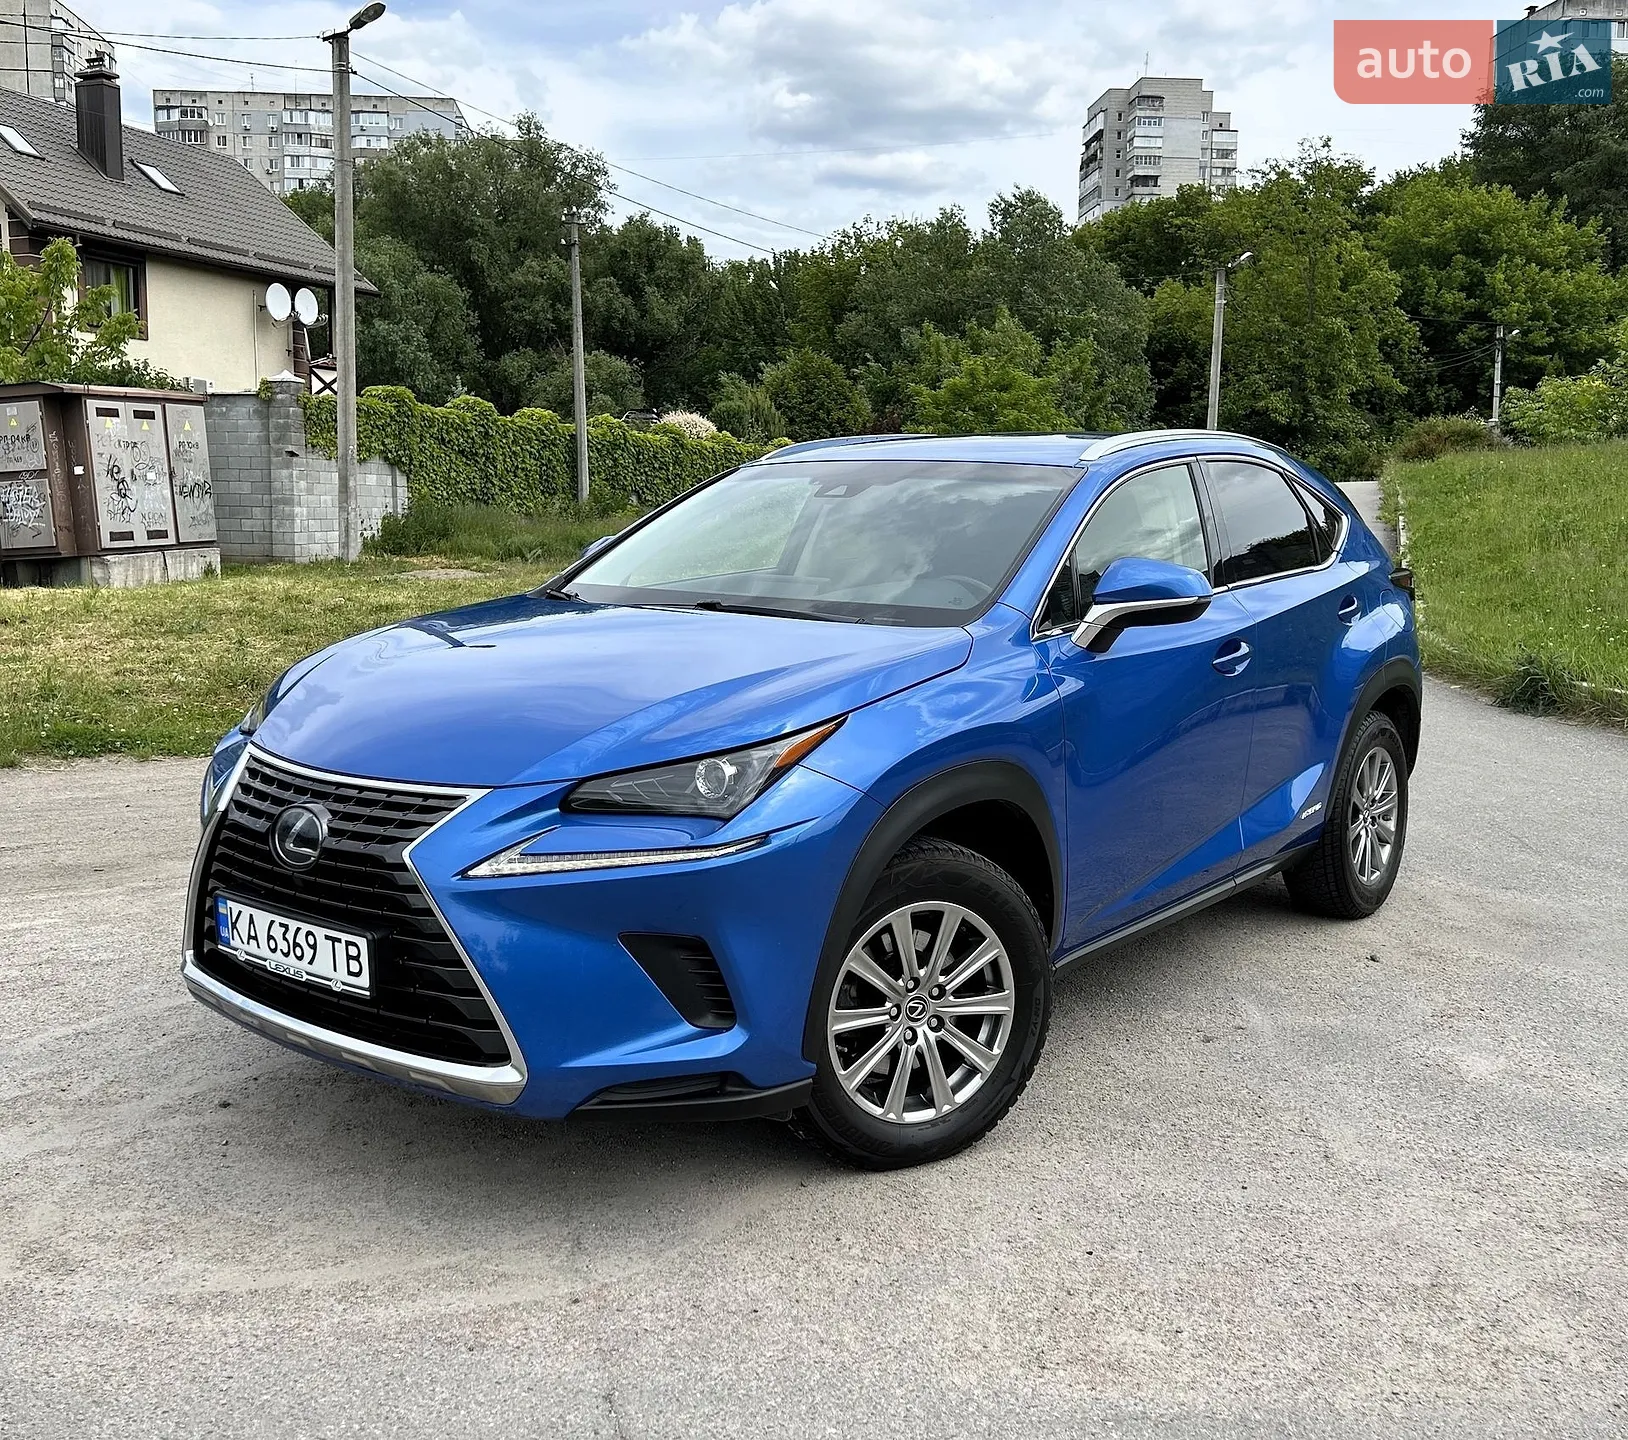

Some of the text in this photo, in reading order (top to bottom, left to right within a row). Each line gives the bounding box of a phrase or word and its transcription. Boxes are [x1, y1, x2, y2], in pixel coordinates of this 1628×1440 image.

[220, 925, 230, 939] UA
[229, 906, 364, 978] KA 6369 TB
[268, 960, 305, 979] LEXUS
